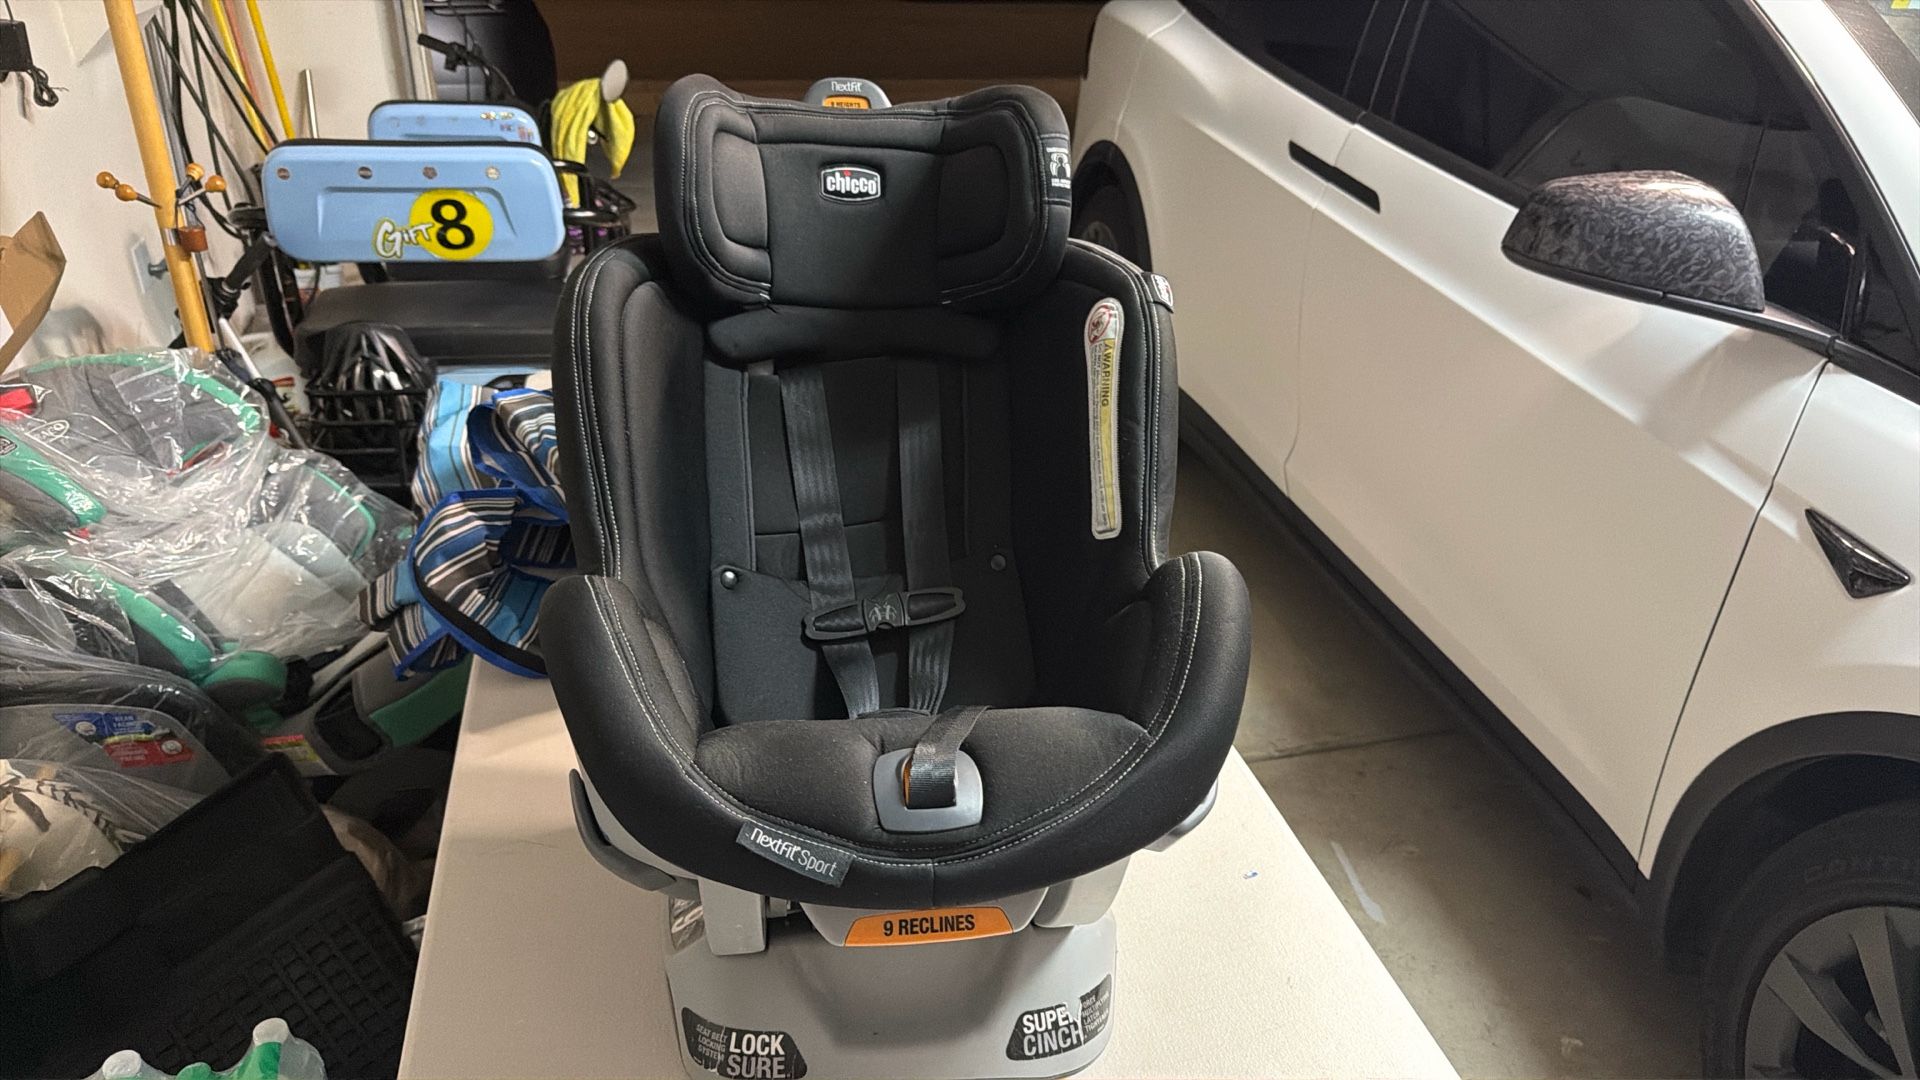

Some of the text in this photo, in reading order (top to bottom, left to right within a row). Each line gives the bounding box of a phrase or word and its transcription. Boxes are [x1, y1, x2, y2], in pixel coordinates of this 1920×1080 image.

[826, 170, 877, 195] chicco
[431, 199, 475, 250] 8
[1101, 351, 1112, 407] WARNING
[798, 849, 837, 877] Sport
[883, 914, 976, 937] 9 RECLINES
[698, 1034, 726, 1052] LOCKING
[729, 1031, 785, 1055] LOCK
